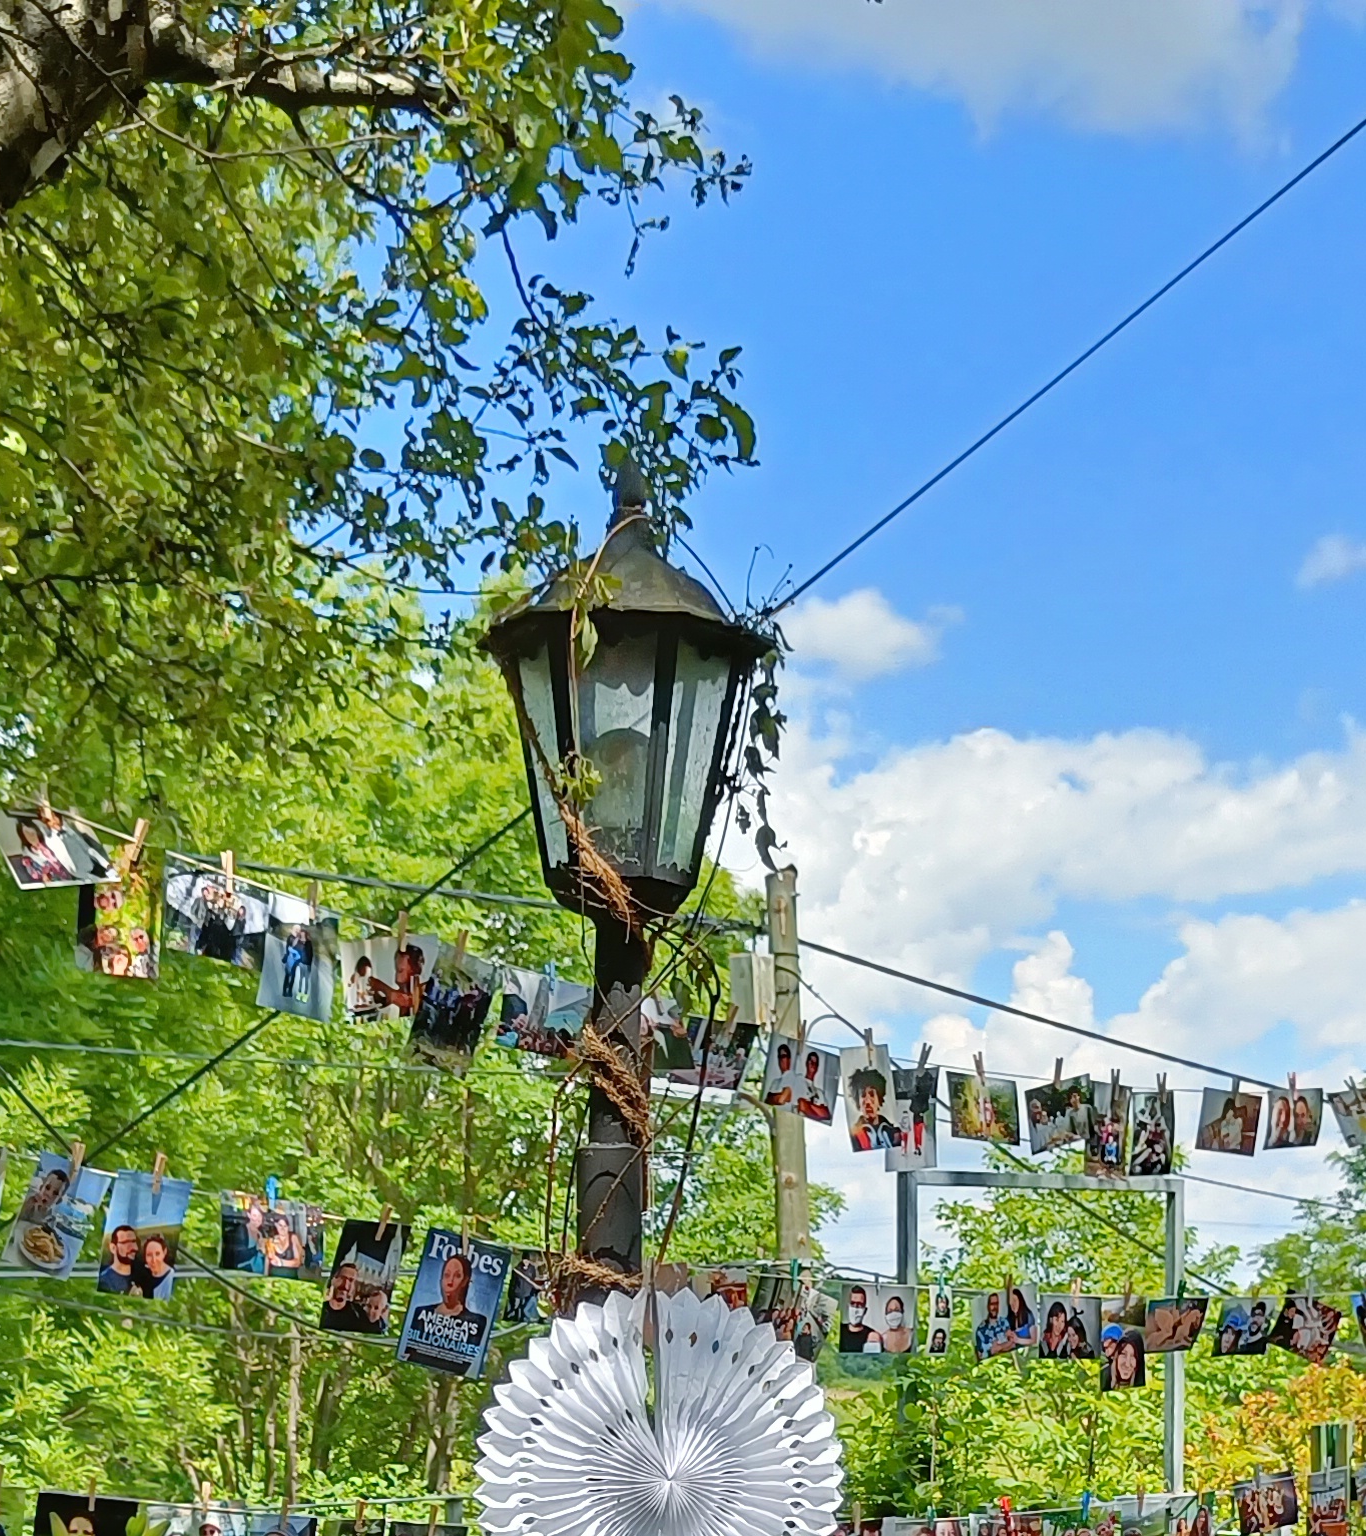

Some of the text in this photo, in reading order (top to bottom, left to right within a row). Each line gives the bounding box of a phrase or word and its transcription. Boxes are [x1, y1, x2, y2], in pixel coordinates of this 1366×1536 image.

[428, 1233, 504, 1277] Fobes
[417, 1309, 479, 1335] AMERICA'S
[424, 1321, 469, 1343] WOMEN
[406, 1328, 482, 1357] BILLIONAIRES
